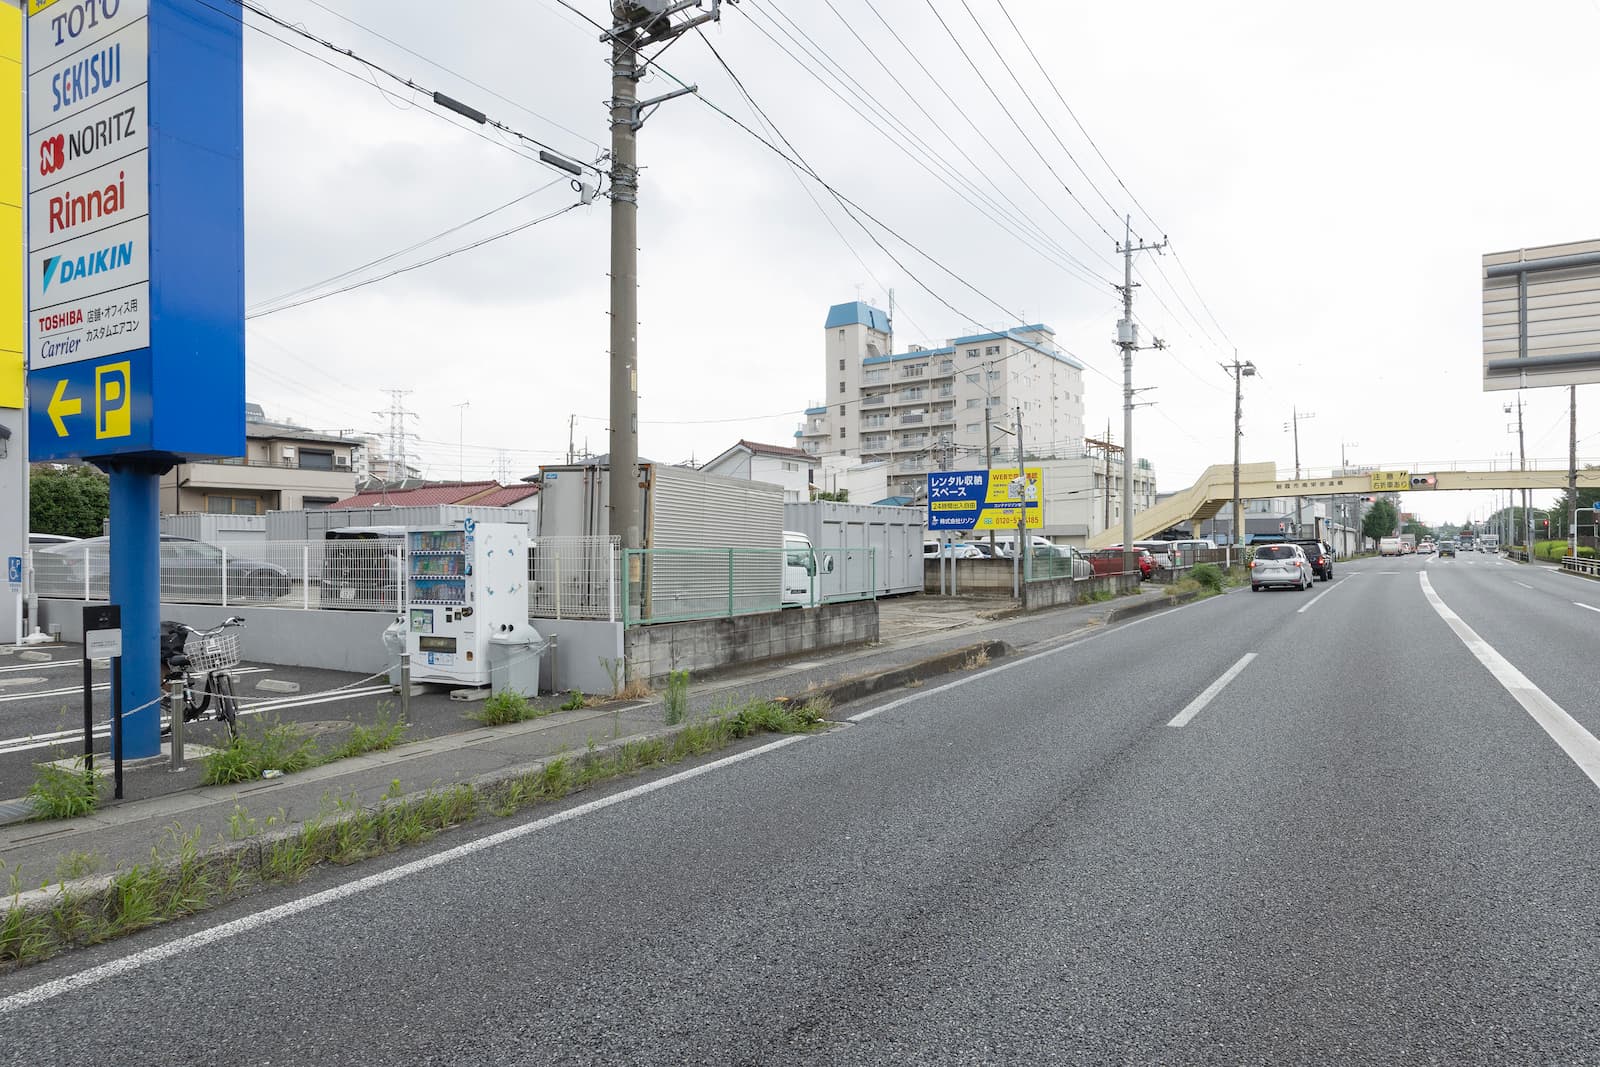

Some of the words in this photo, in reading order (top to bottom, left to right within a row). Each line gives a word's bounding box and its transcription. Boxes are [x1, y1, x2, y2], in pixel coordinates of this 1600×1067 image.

[51, 0, 120, 47] TOTO
[52, 43, 121, 112] SEKISUI
[69, 107, 136, 160] NORITZ
[49, 171, 125, 233] Rinnai
[59, 241, 133, 284] DAIKIN
[38, 309, 84, 332] TOSHIBA
[86, 320, 140, 342] カスタムエアコン
[41, 336, 81, 359] Carrier
[100, 369, 126, 432] P
[931, 475, 983, 487] レンタル収納
[931, 487, 967, 497] スペース
